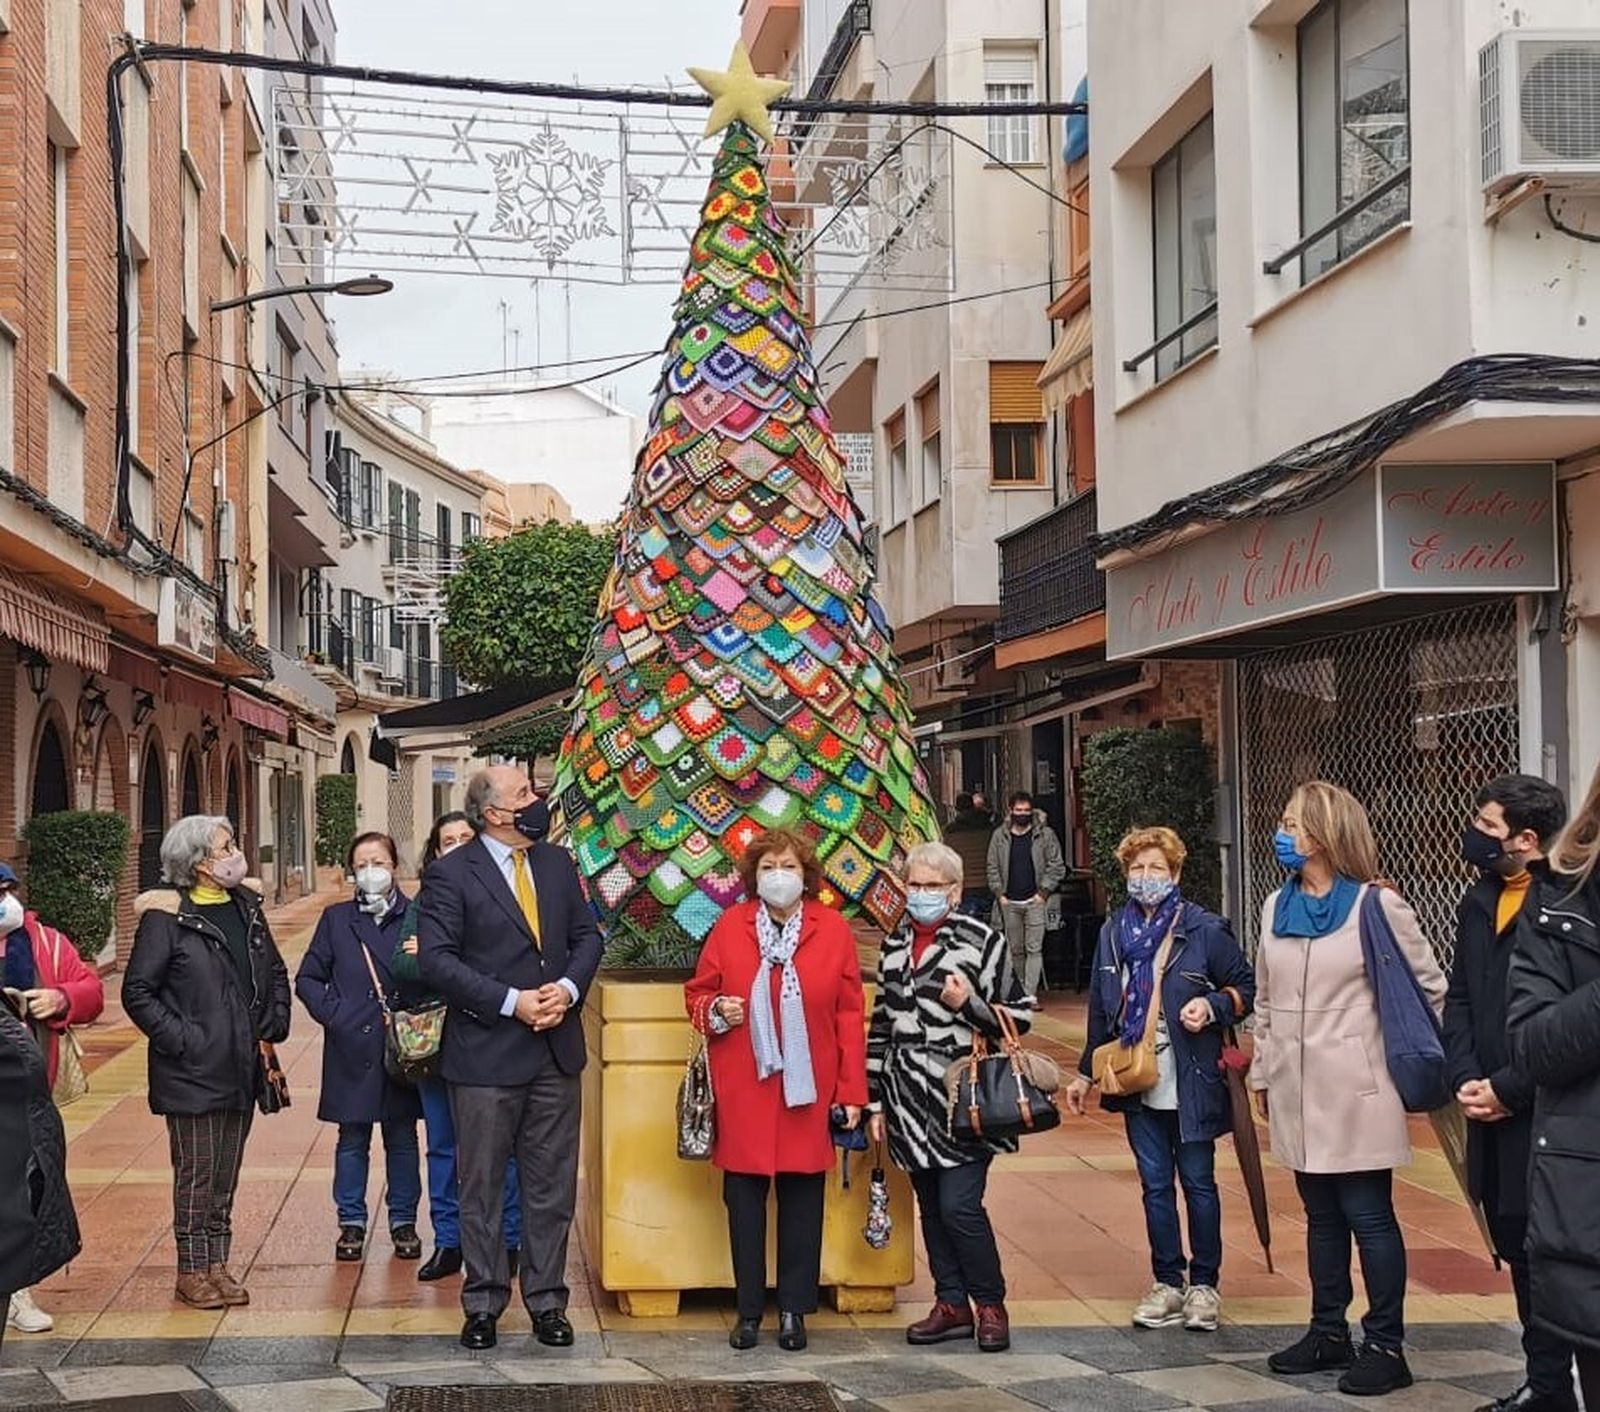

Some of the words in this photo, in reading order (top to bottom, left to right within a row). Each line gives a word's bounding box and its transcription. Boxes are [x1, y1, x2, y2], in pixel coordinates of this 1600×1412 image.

[1387, 477, 1518, 516] Arte
[1522, 498, 1549, 526] y
[1128, 562, 1200, 633] Arte
[1211, 571, 1231, 625] y
[1241, 516, 1334, 606] Estilo
[1407, 527, 1527, 574] Estilo
